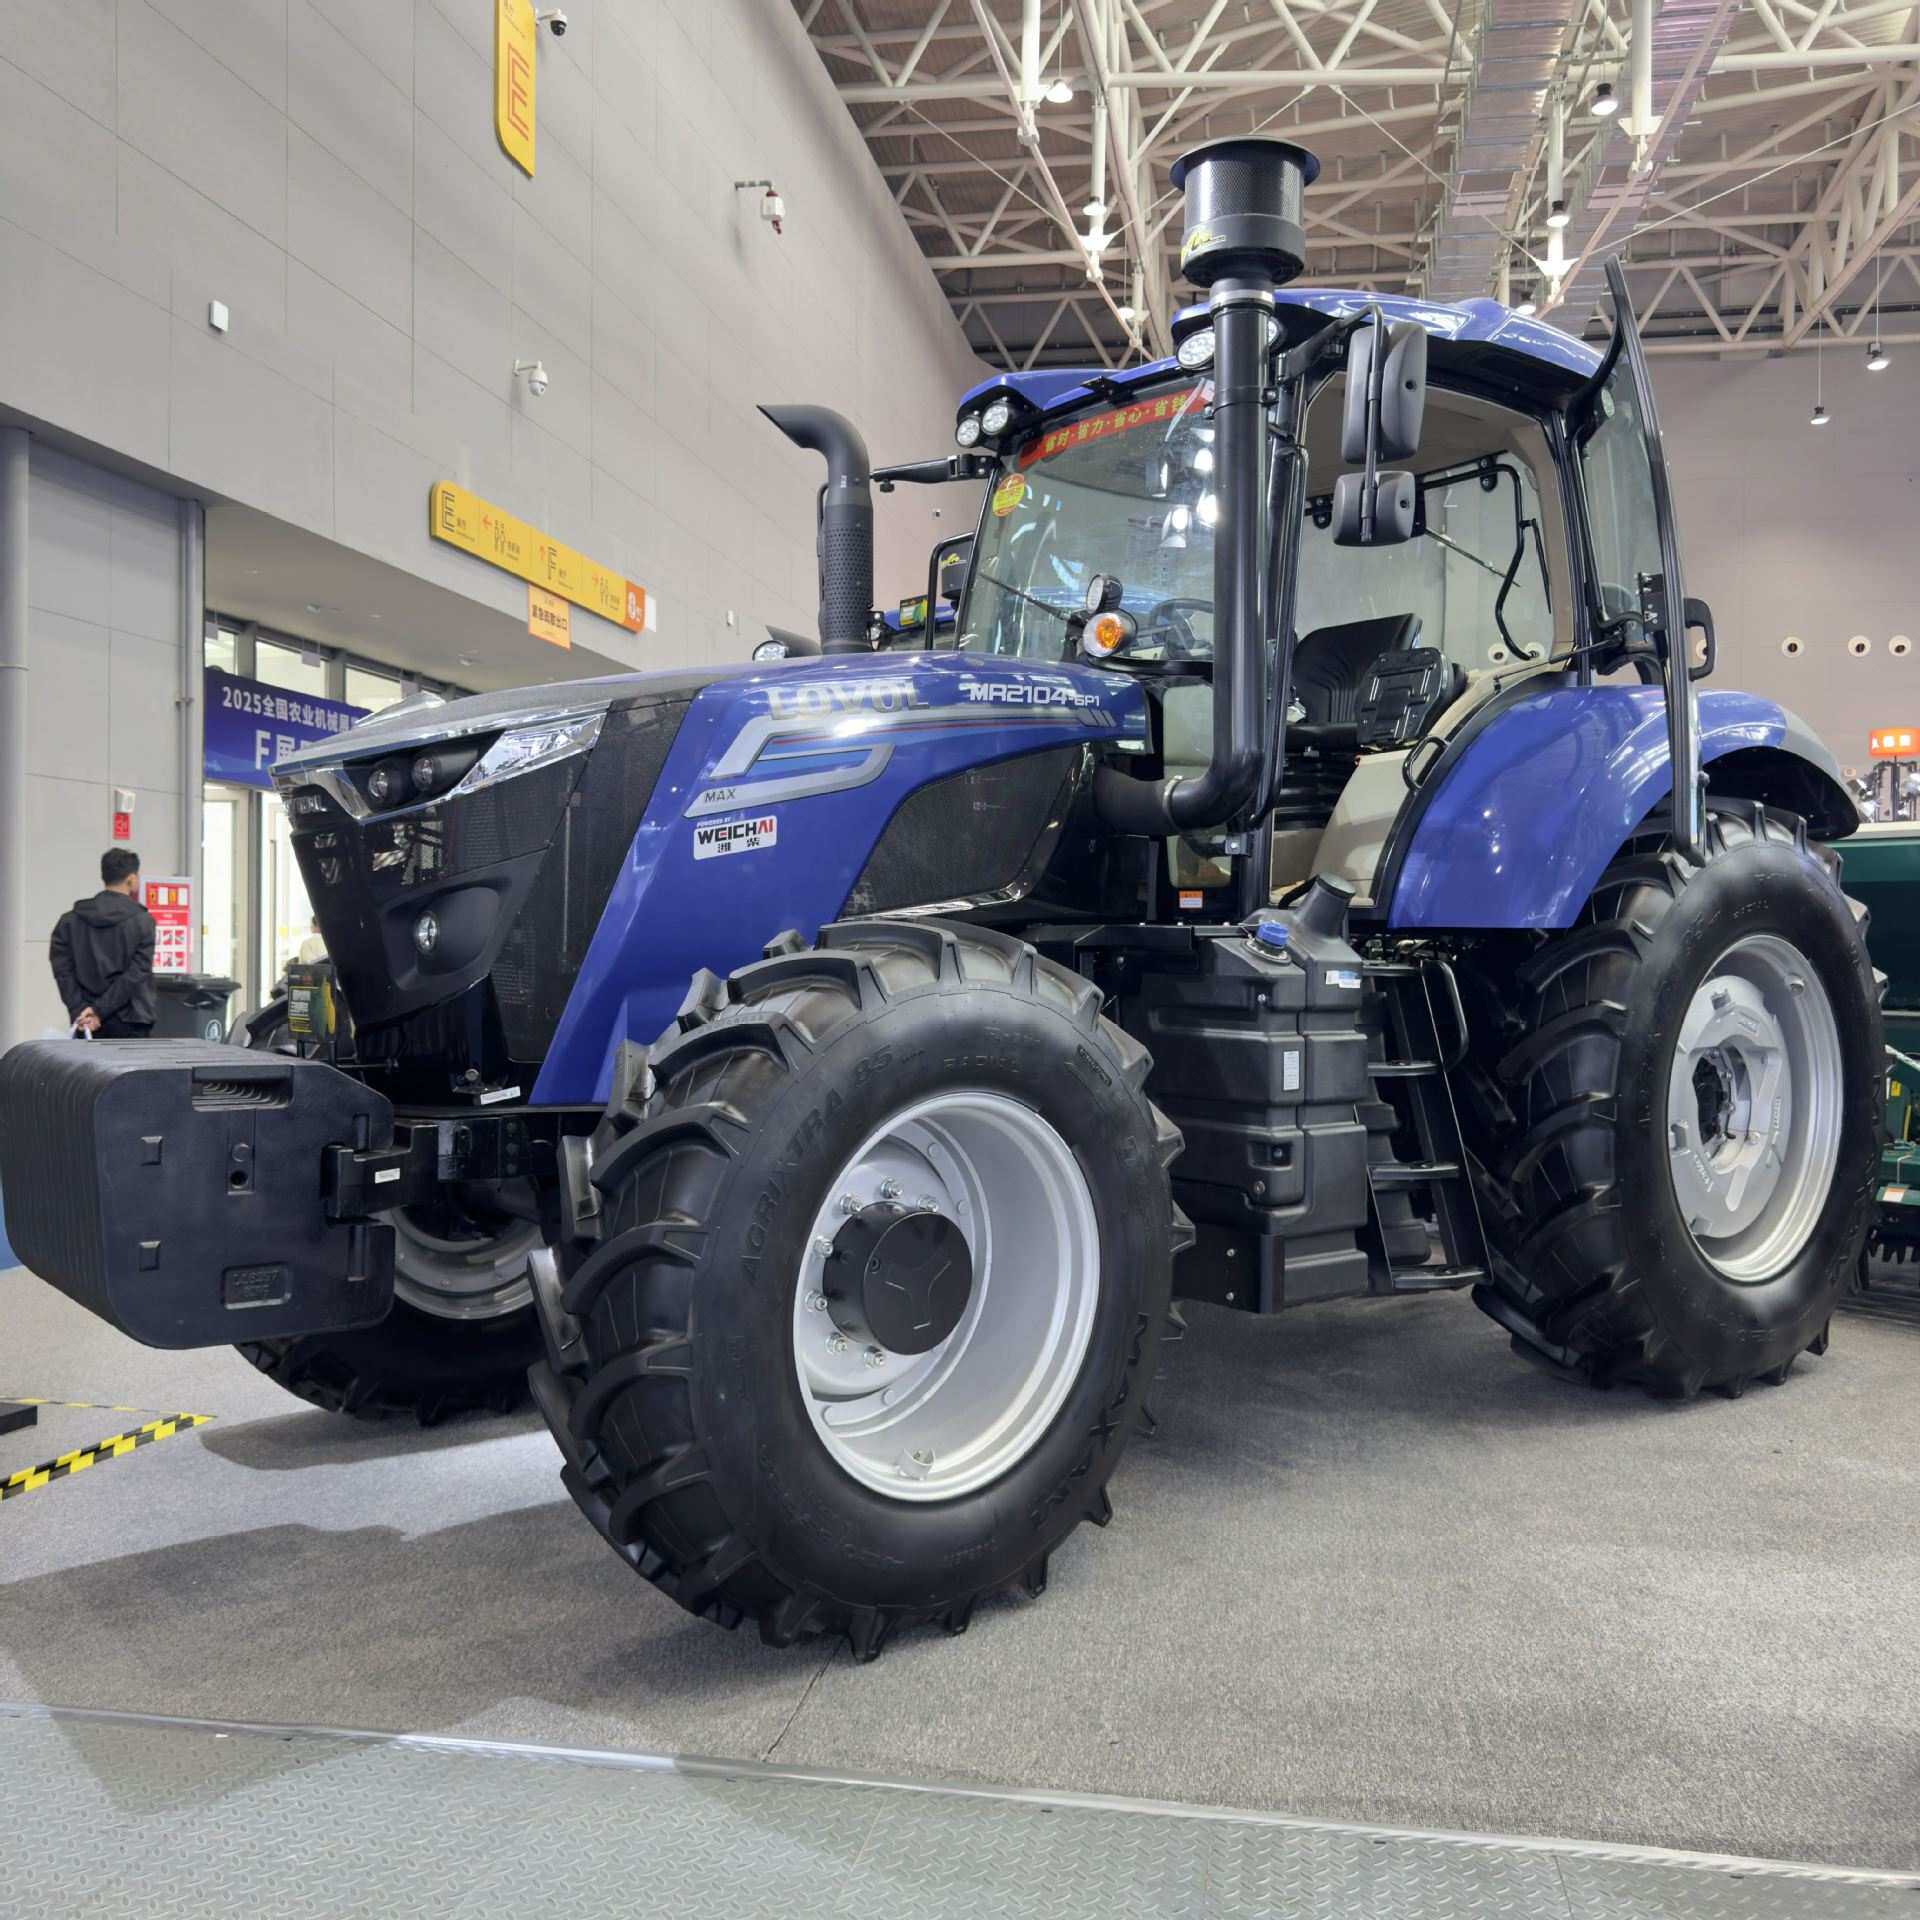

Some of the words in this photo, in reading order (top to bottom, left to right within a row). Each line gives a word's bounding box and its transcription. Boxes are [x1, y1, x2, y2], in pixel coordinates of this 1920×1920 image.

[508, 41, 529, 141] E
[442, 490, 455, 532] E
[768, 677, 928, 720] LOVOL
[705, 789, 735, 802] MAX
[698, 819, 774, 845] WEICHAI
